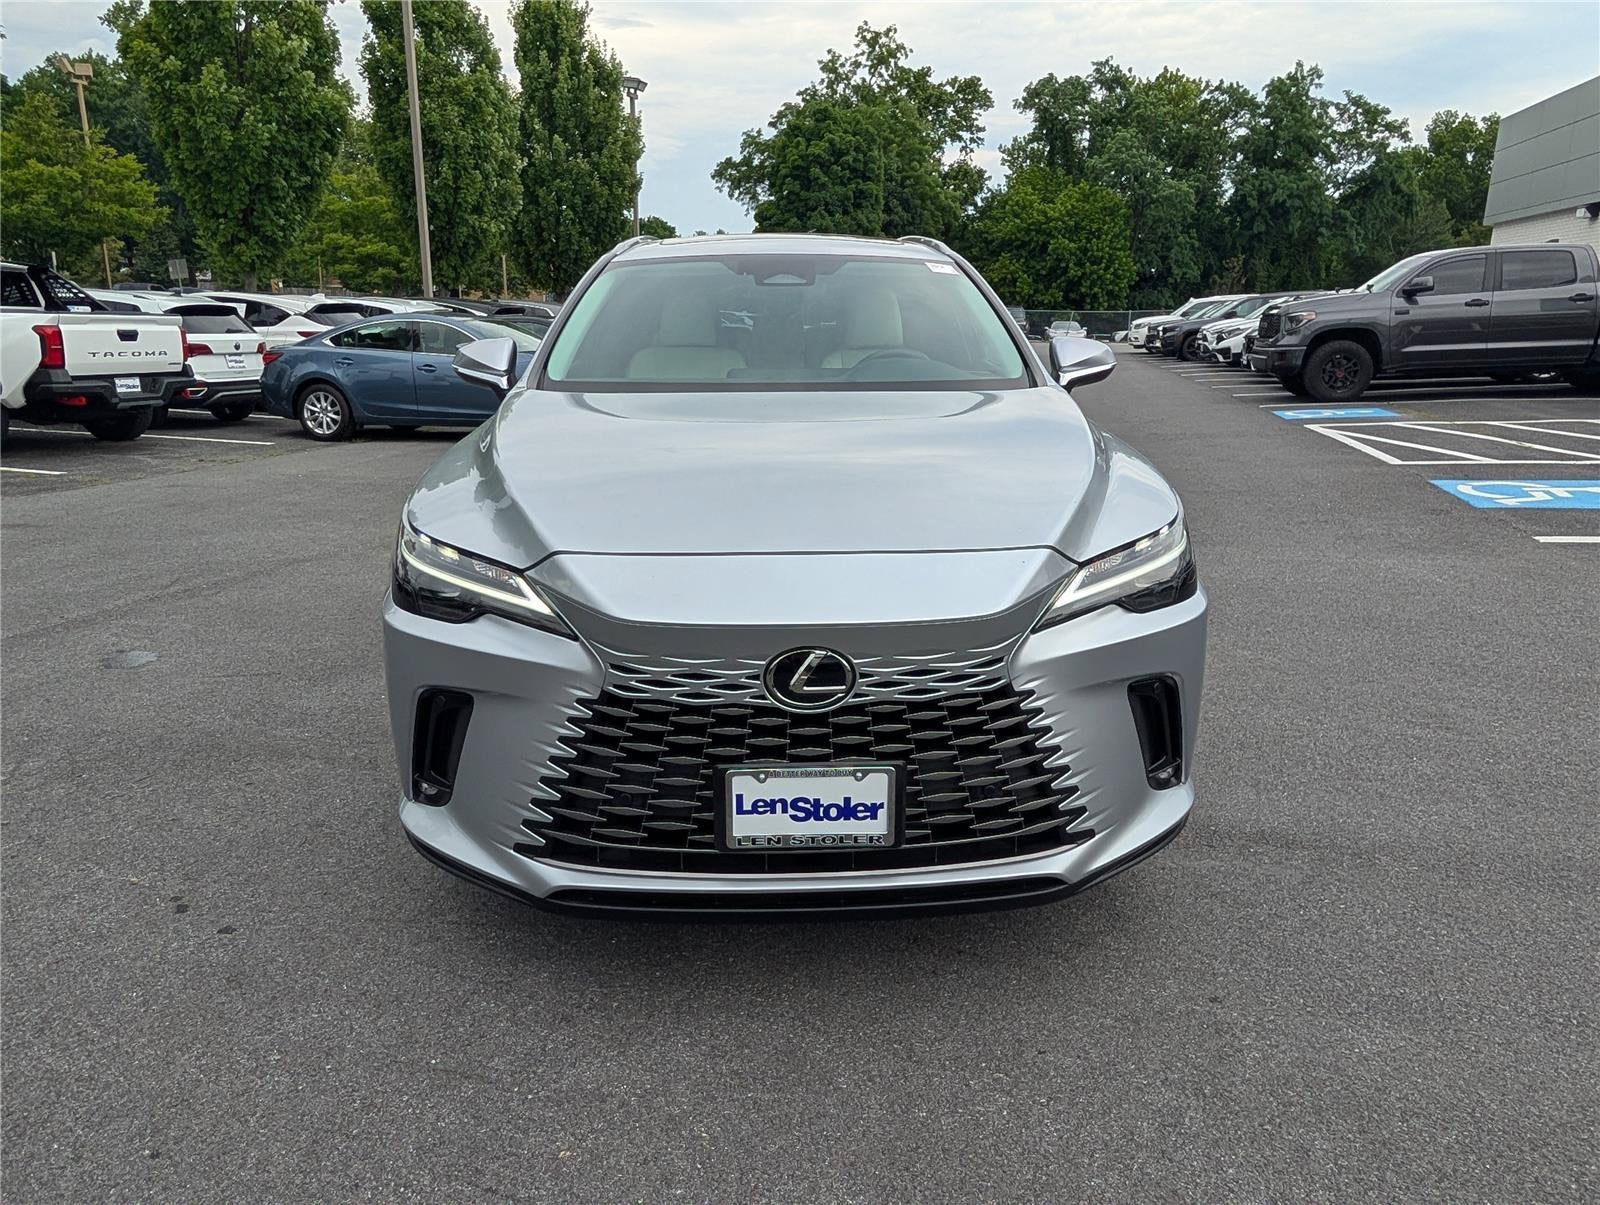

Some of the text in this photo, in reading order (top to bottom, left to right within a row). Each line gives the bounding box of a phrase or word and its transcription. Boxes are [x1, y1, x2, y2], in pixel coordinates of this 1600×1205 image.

[88, 350, 168, 358] TACOMA
[736, 835, 885, 847] LEN STOLER
